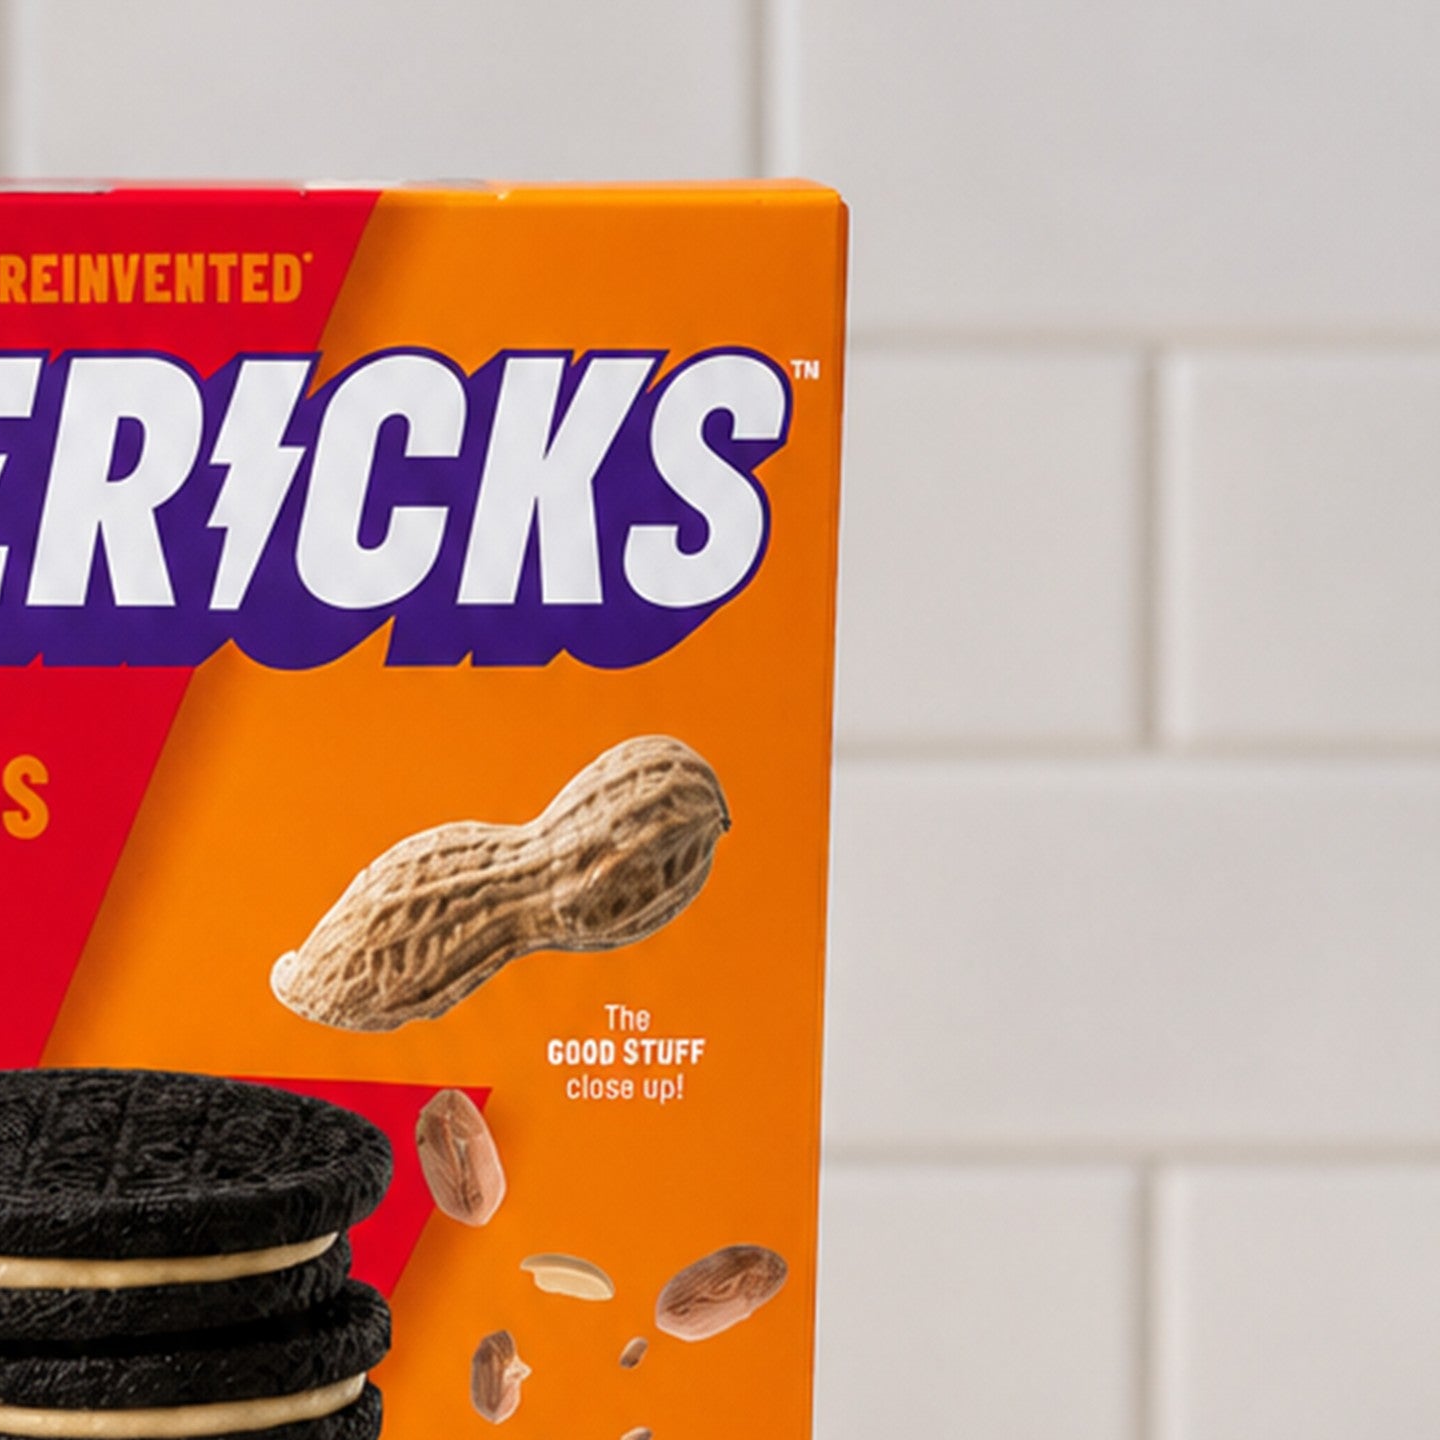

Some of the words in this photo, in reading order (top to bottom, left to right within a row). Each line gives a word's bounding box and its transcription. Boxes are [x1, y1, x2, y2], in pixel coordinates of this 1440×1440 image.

[604, 1004, 651, 1032] The
[547, 1038, 616, 1066] GOOD
[623, 1038, 706, 1065] STUFF
[566, 1074, 635, 1099] close
[643, 1074, 684, 1104] up!
